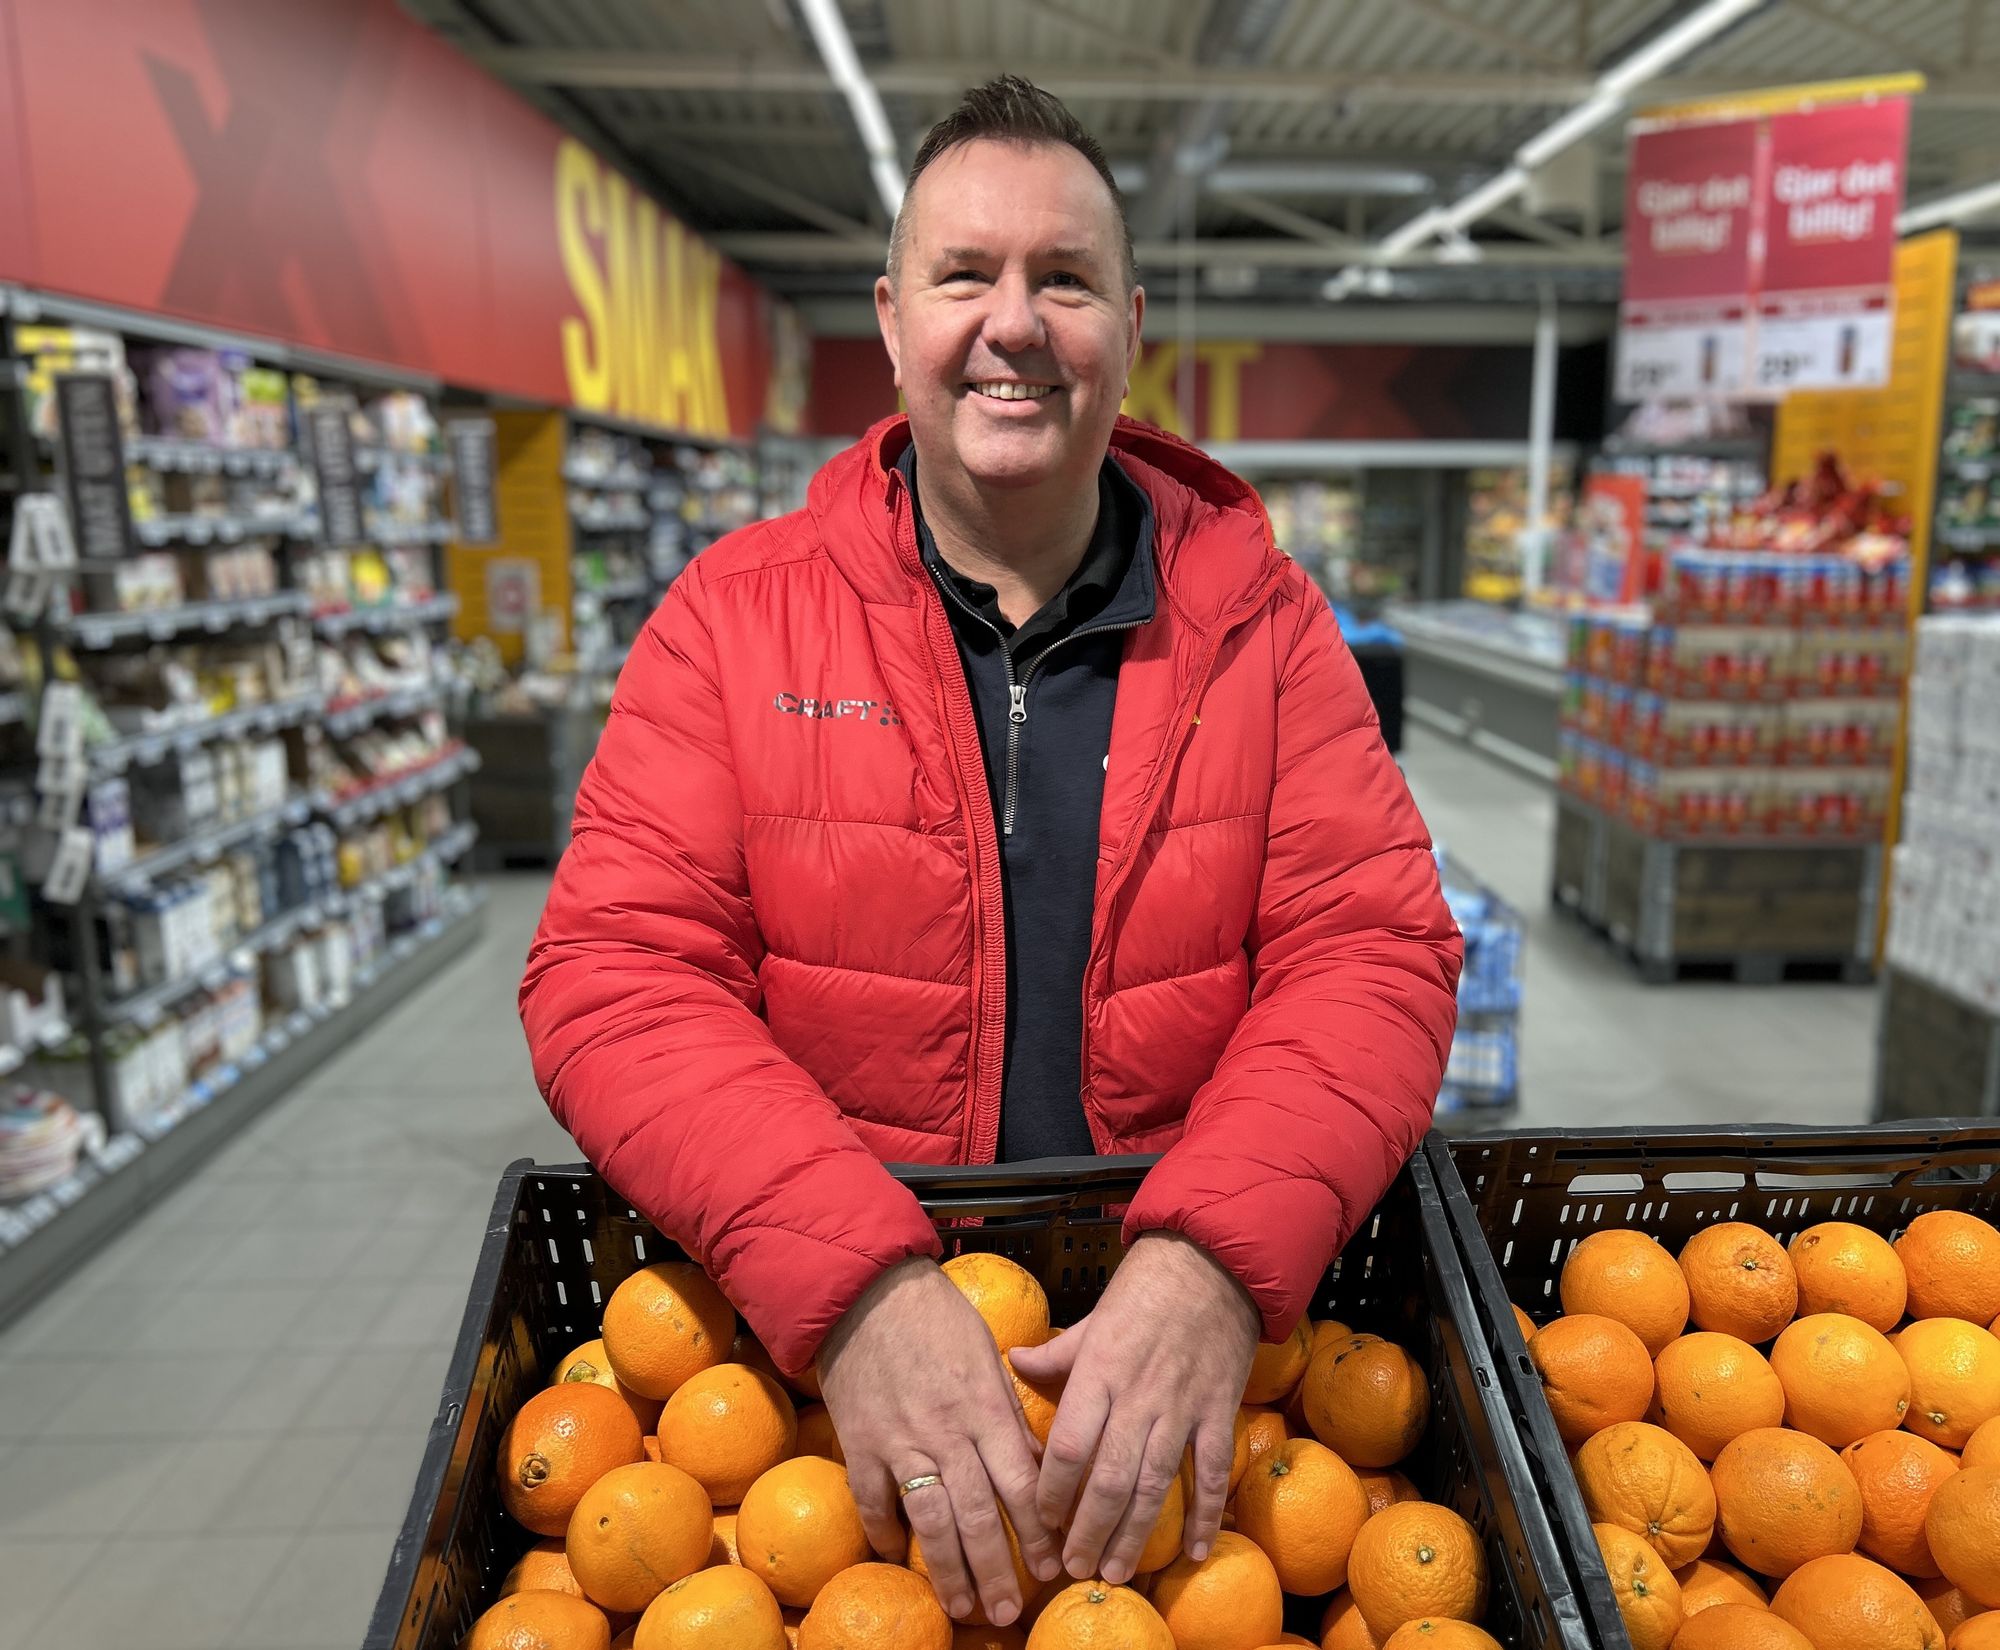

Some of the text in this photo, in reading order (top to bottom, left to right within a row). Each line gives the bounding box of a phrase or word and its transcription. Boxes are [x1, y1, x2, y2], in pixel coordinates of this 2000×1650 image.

[1839, 158, 1894, 198] det
[557, 138, 731, 440] SMAK
[1121, 341, 1262, 443] KT
[773, 692, 878, 721] CRAFT
